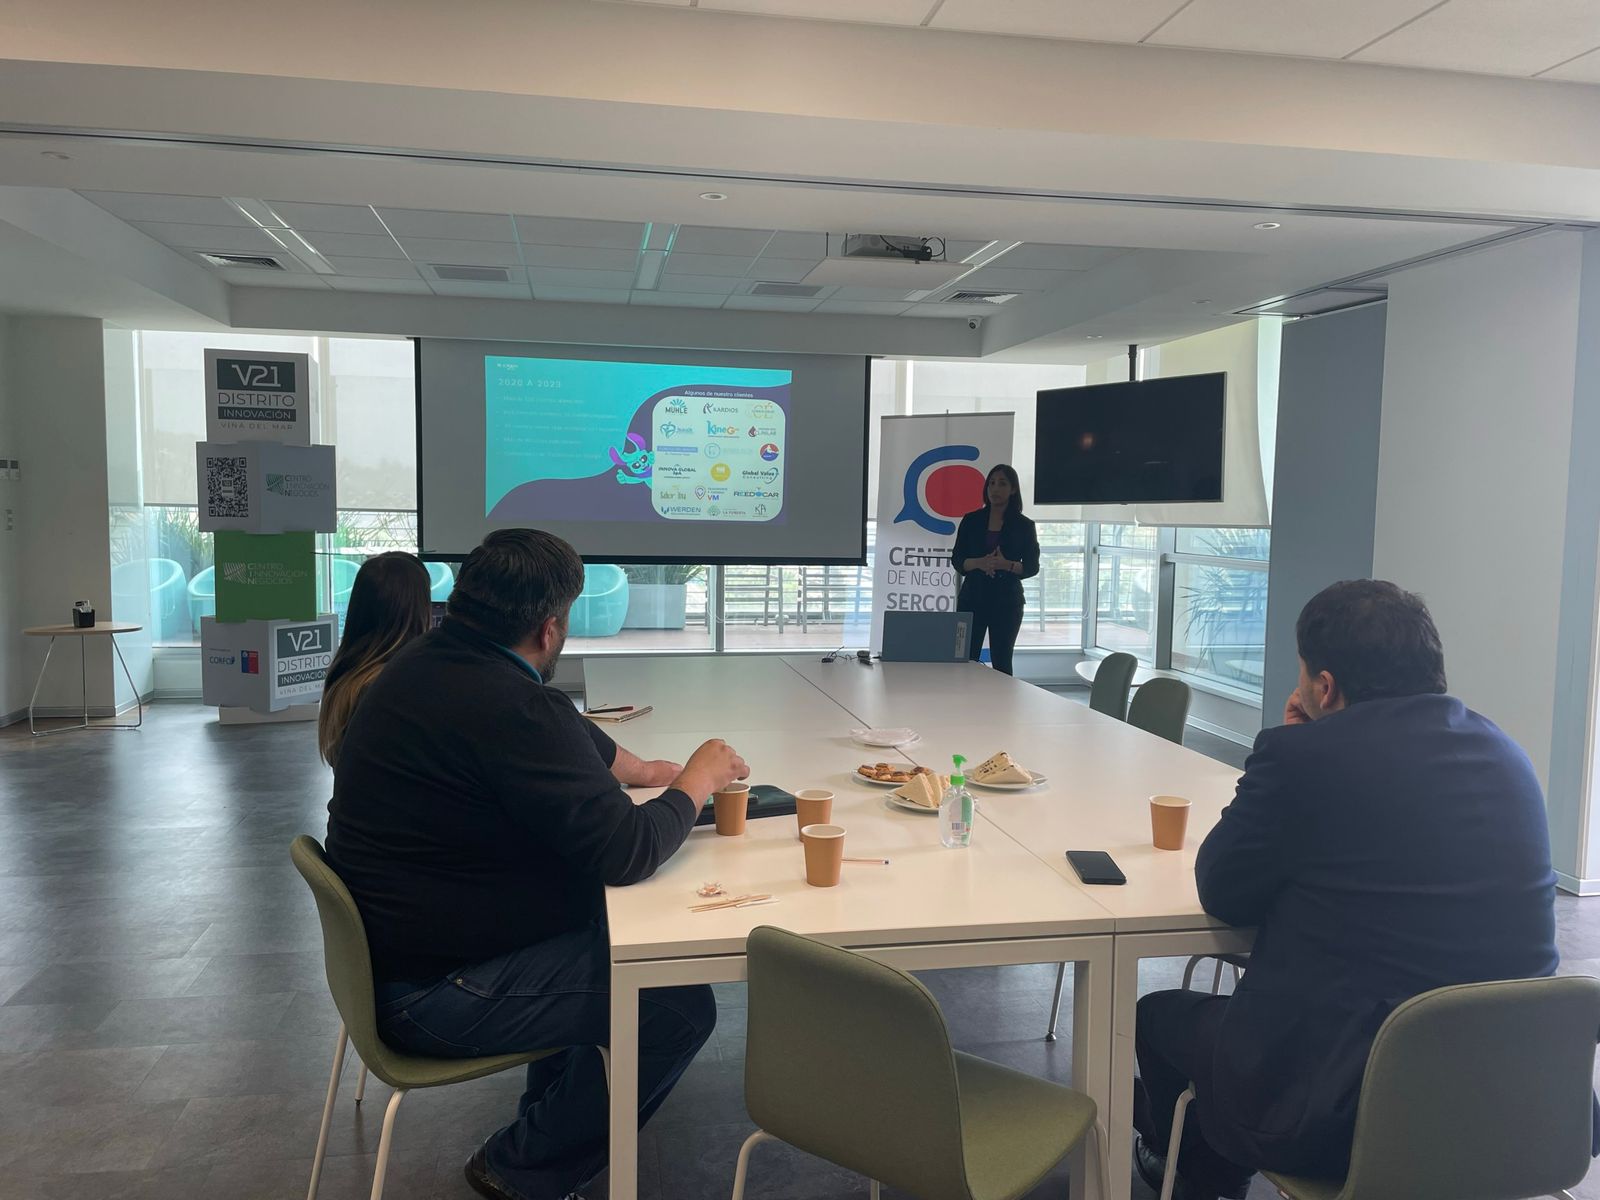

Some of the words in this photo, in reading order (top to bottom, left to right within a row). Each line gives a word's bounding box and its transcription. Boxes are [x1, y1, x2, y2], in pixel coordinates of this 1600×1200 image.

[231, 364, 281, 387] V21
[218, 392, 295, 407] DISTRITO
[888, 569, 906, 585] DE
[288, 629, 322, 652] V21
[278, 655, 331, 672] DISTRITO
